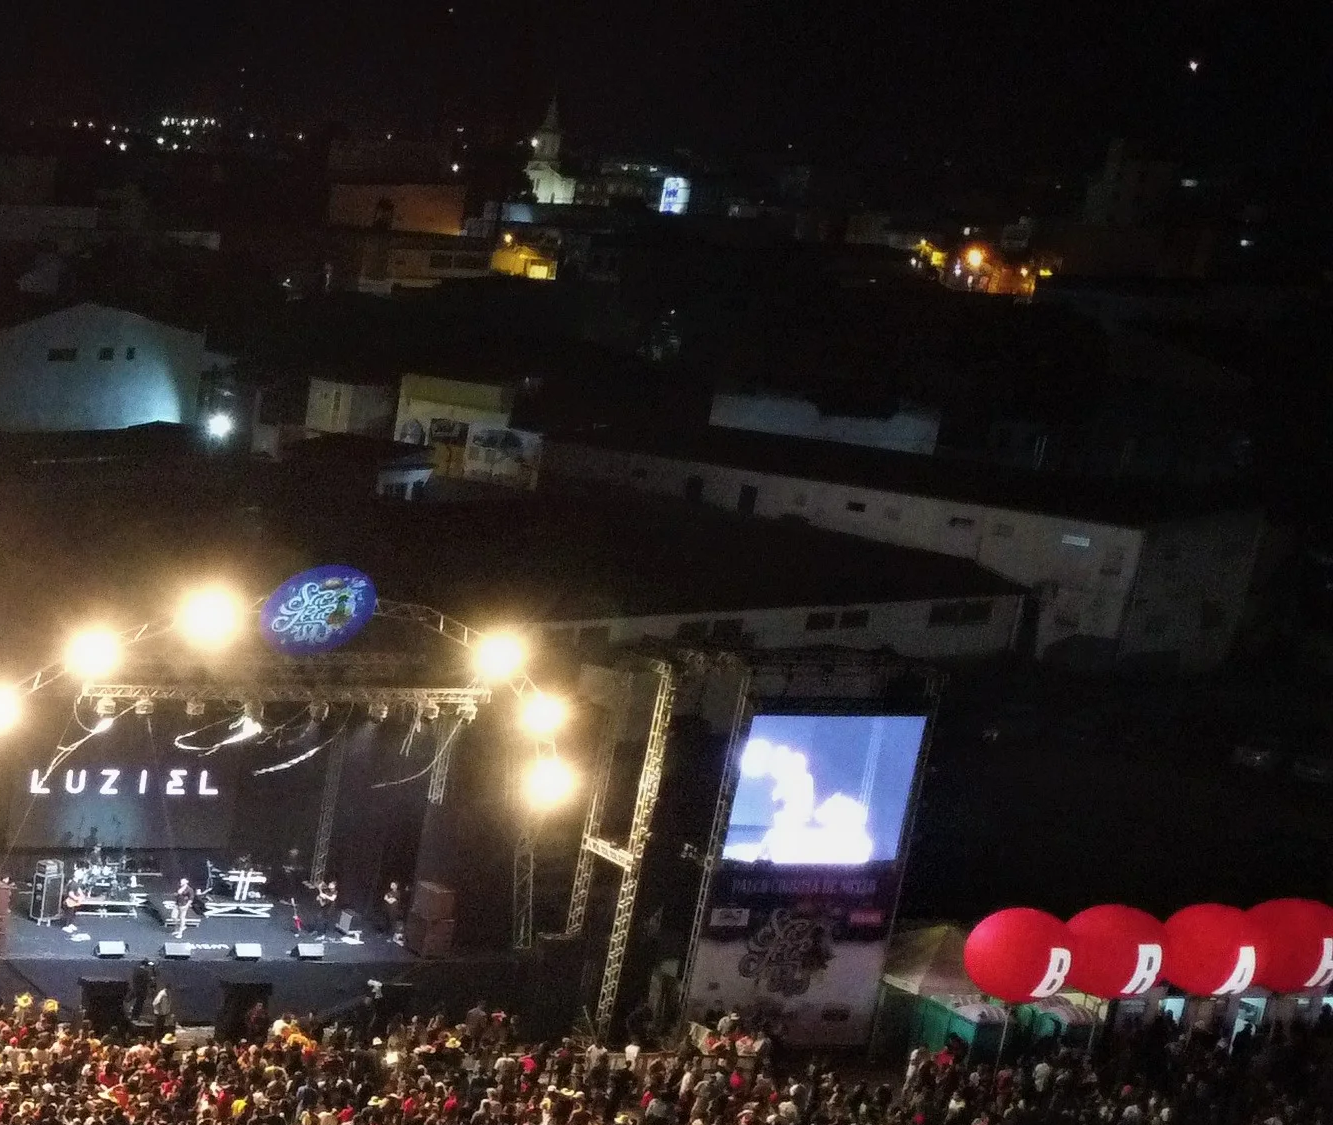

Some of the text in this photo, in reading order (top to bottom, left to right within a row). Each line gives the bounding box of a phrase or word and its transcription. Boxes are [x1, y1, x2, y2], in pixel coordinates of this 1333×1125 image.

[30, 769, 219, 795] LUZIEL
[1029, 948, 1072, 998] B
[1120, 944, 1163, 994] R
[1212, 946, 1256, 995] A
